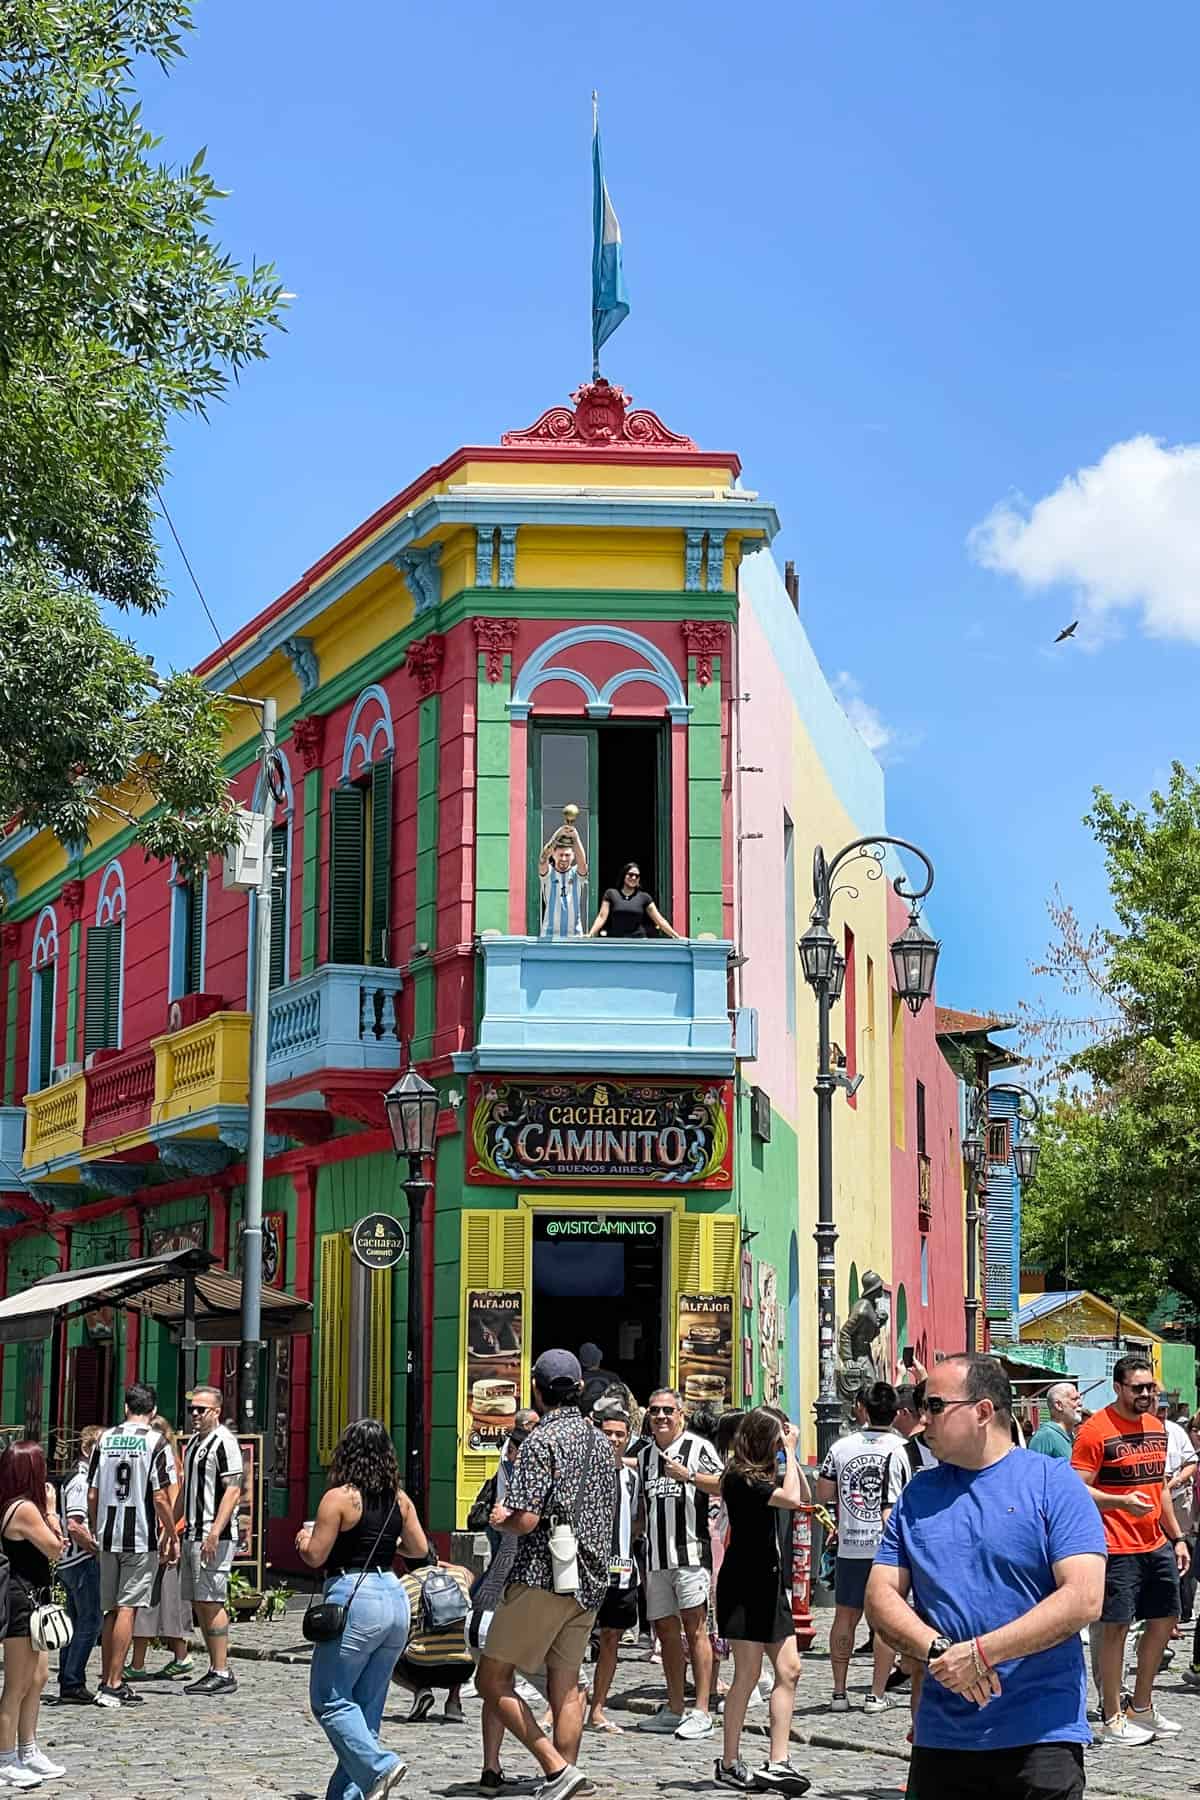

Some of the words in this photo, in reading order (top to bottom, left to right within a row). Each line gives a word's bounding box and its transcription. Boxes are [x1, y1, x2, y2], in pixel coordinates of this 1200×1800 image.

[517, 1124, 687, 1165] CAMINITO
[558, 1164, 605, 1173] BUENOS
[610, 1165, 645, 1174] AIRES
[546, 1220, 657, 1236] @VISITCAMINITO
[472, 1299, 520, 1309] ALFAJOR
[682, 1302, 730, 1312] ALFAJOR
[104, 1435, 147, 1452] TENDA
[115, 1461, 131, 1501] 9
